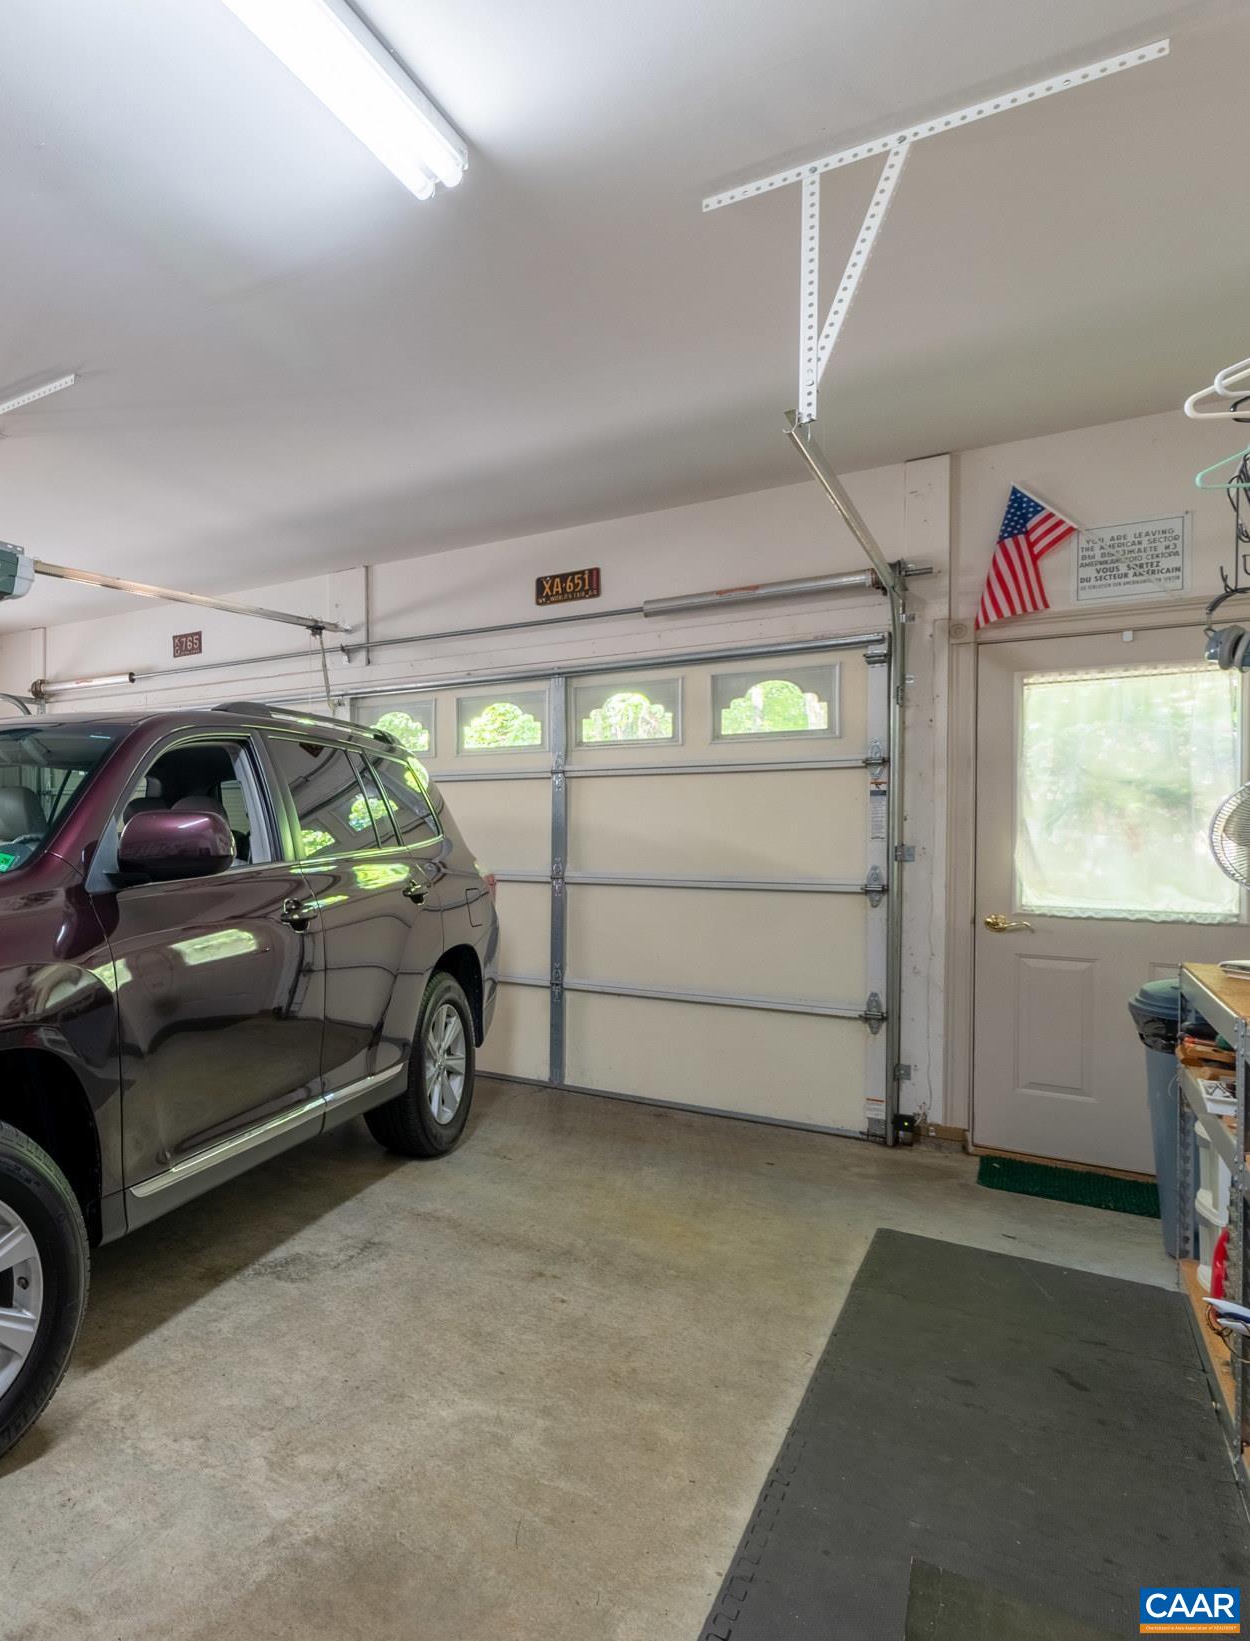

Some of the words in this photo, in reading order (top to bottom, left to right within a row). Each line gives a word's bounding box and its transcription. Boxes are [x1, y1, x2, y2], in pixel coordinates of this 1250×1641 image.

[1134, 528, 1174, 539] LEAVING
[1148, 534, 1180, 545] SECTOR
[1095, 566, 1120, 575] VOUS
[1094, 572, 1129, 582] SECTEUR
